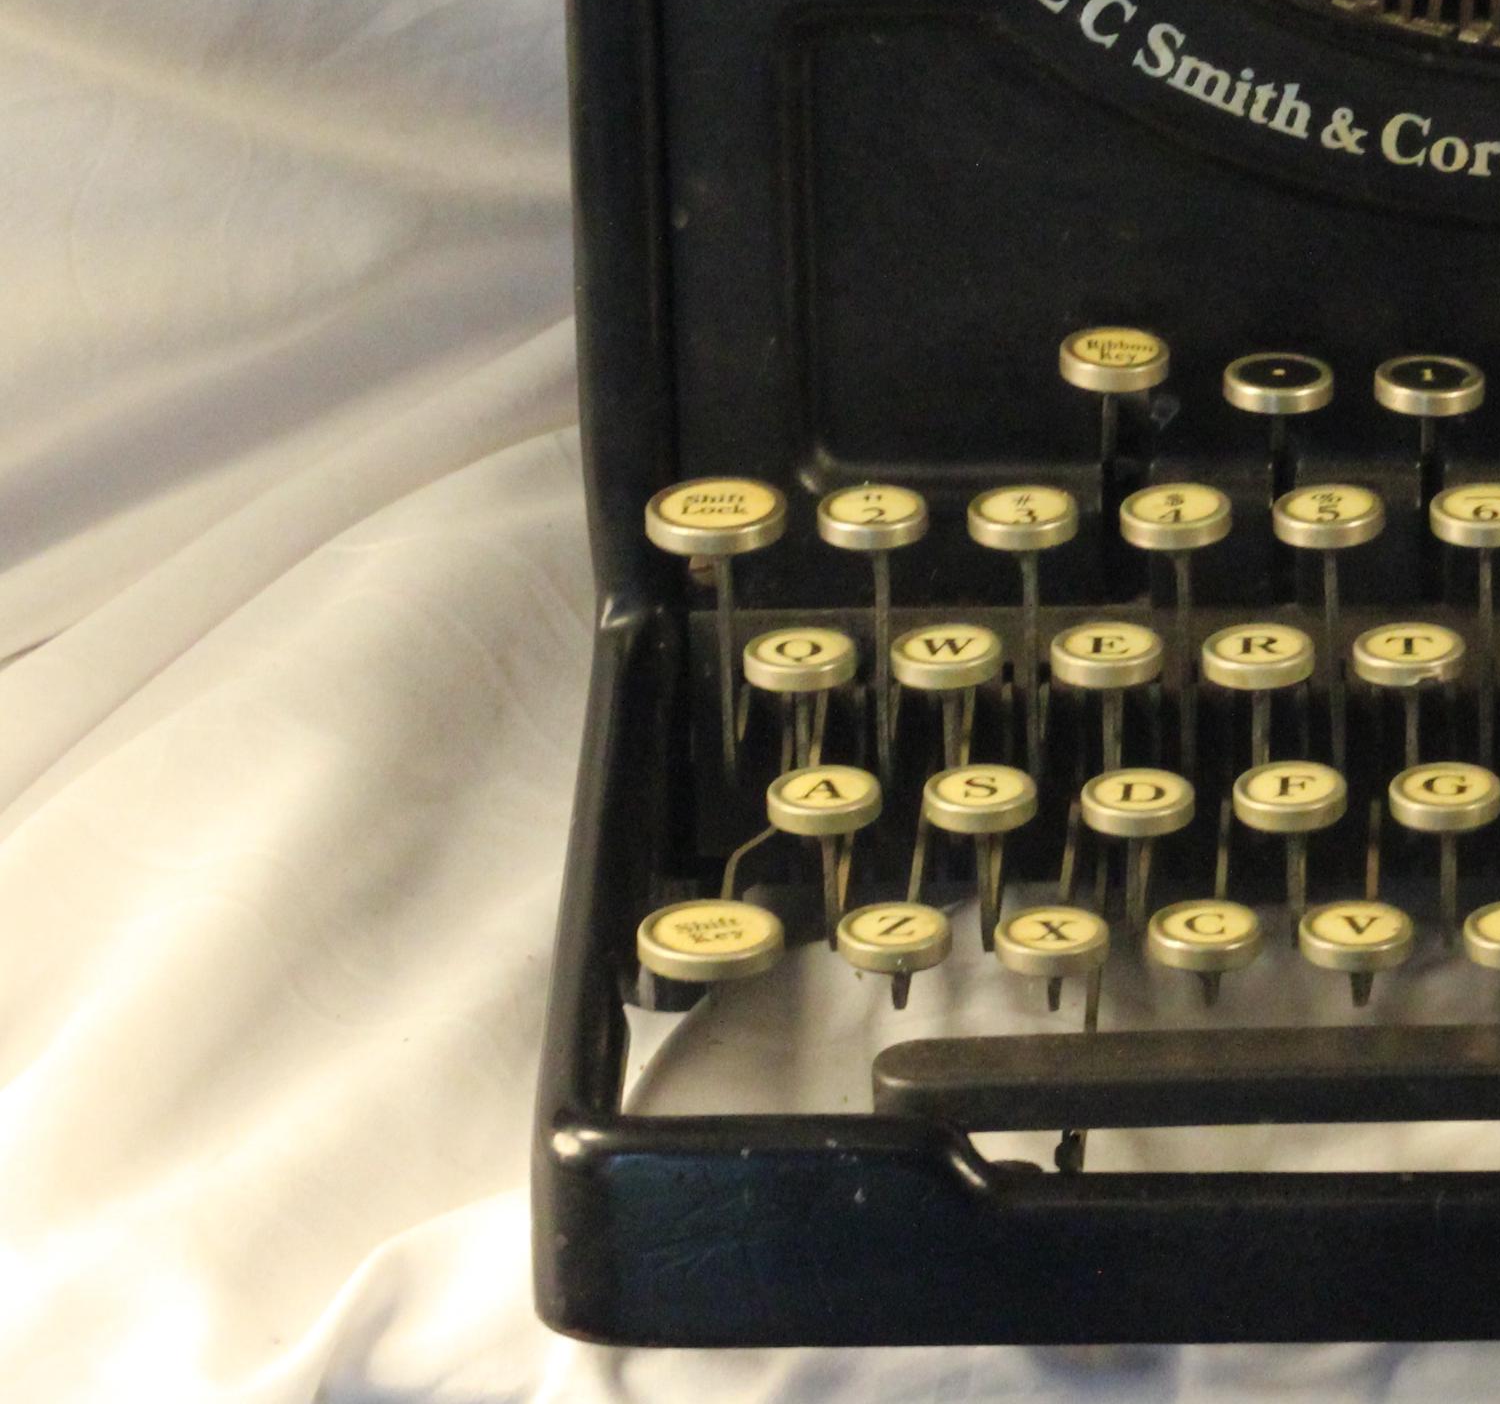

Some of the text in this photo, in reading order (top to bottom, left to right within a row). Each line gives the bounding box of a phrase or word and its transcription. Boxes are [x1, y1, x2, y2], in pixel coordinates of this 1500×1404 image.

[1132, 23, 1310, 139] Smith
[1321, 107, 1366, 156] &
[1086, 339, 1154, 353] Ribbon
[1100, 350, 1137, 366] Key
[1422, 368, 1434, 382] 1
[681, 502, 749, 516] Lock
[860, 507, 887, 524] 2
[1012, 507, 1037, 524] 3
[1158, 508, 1182, 523] 4
[1316, 504, 1341, 523] 5
[1472, 504, 1499, 521] 6
[922, 636, 976, 656] W
[1088, 635, 1130, 656] E
[1235, 635, 1284, 655] R
[1385, 635, 1434, 656] T
[800, 779, 846, 800] A
[963, 776, 999, 799] S
[1118, 782, 1166, 802] D
[1273, 775, 1318, 797] F
[1421, 774, 1468, 797] G
[878, 916, 916, 937] Z
[1031, 920, 1073, 941] X
[1185, 914, 1225, 935] C
[1341, 916, 1380, 935] V
[690, 929, 743, 944] Key
